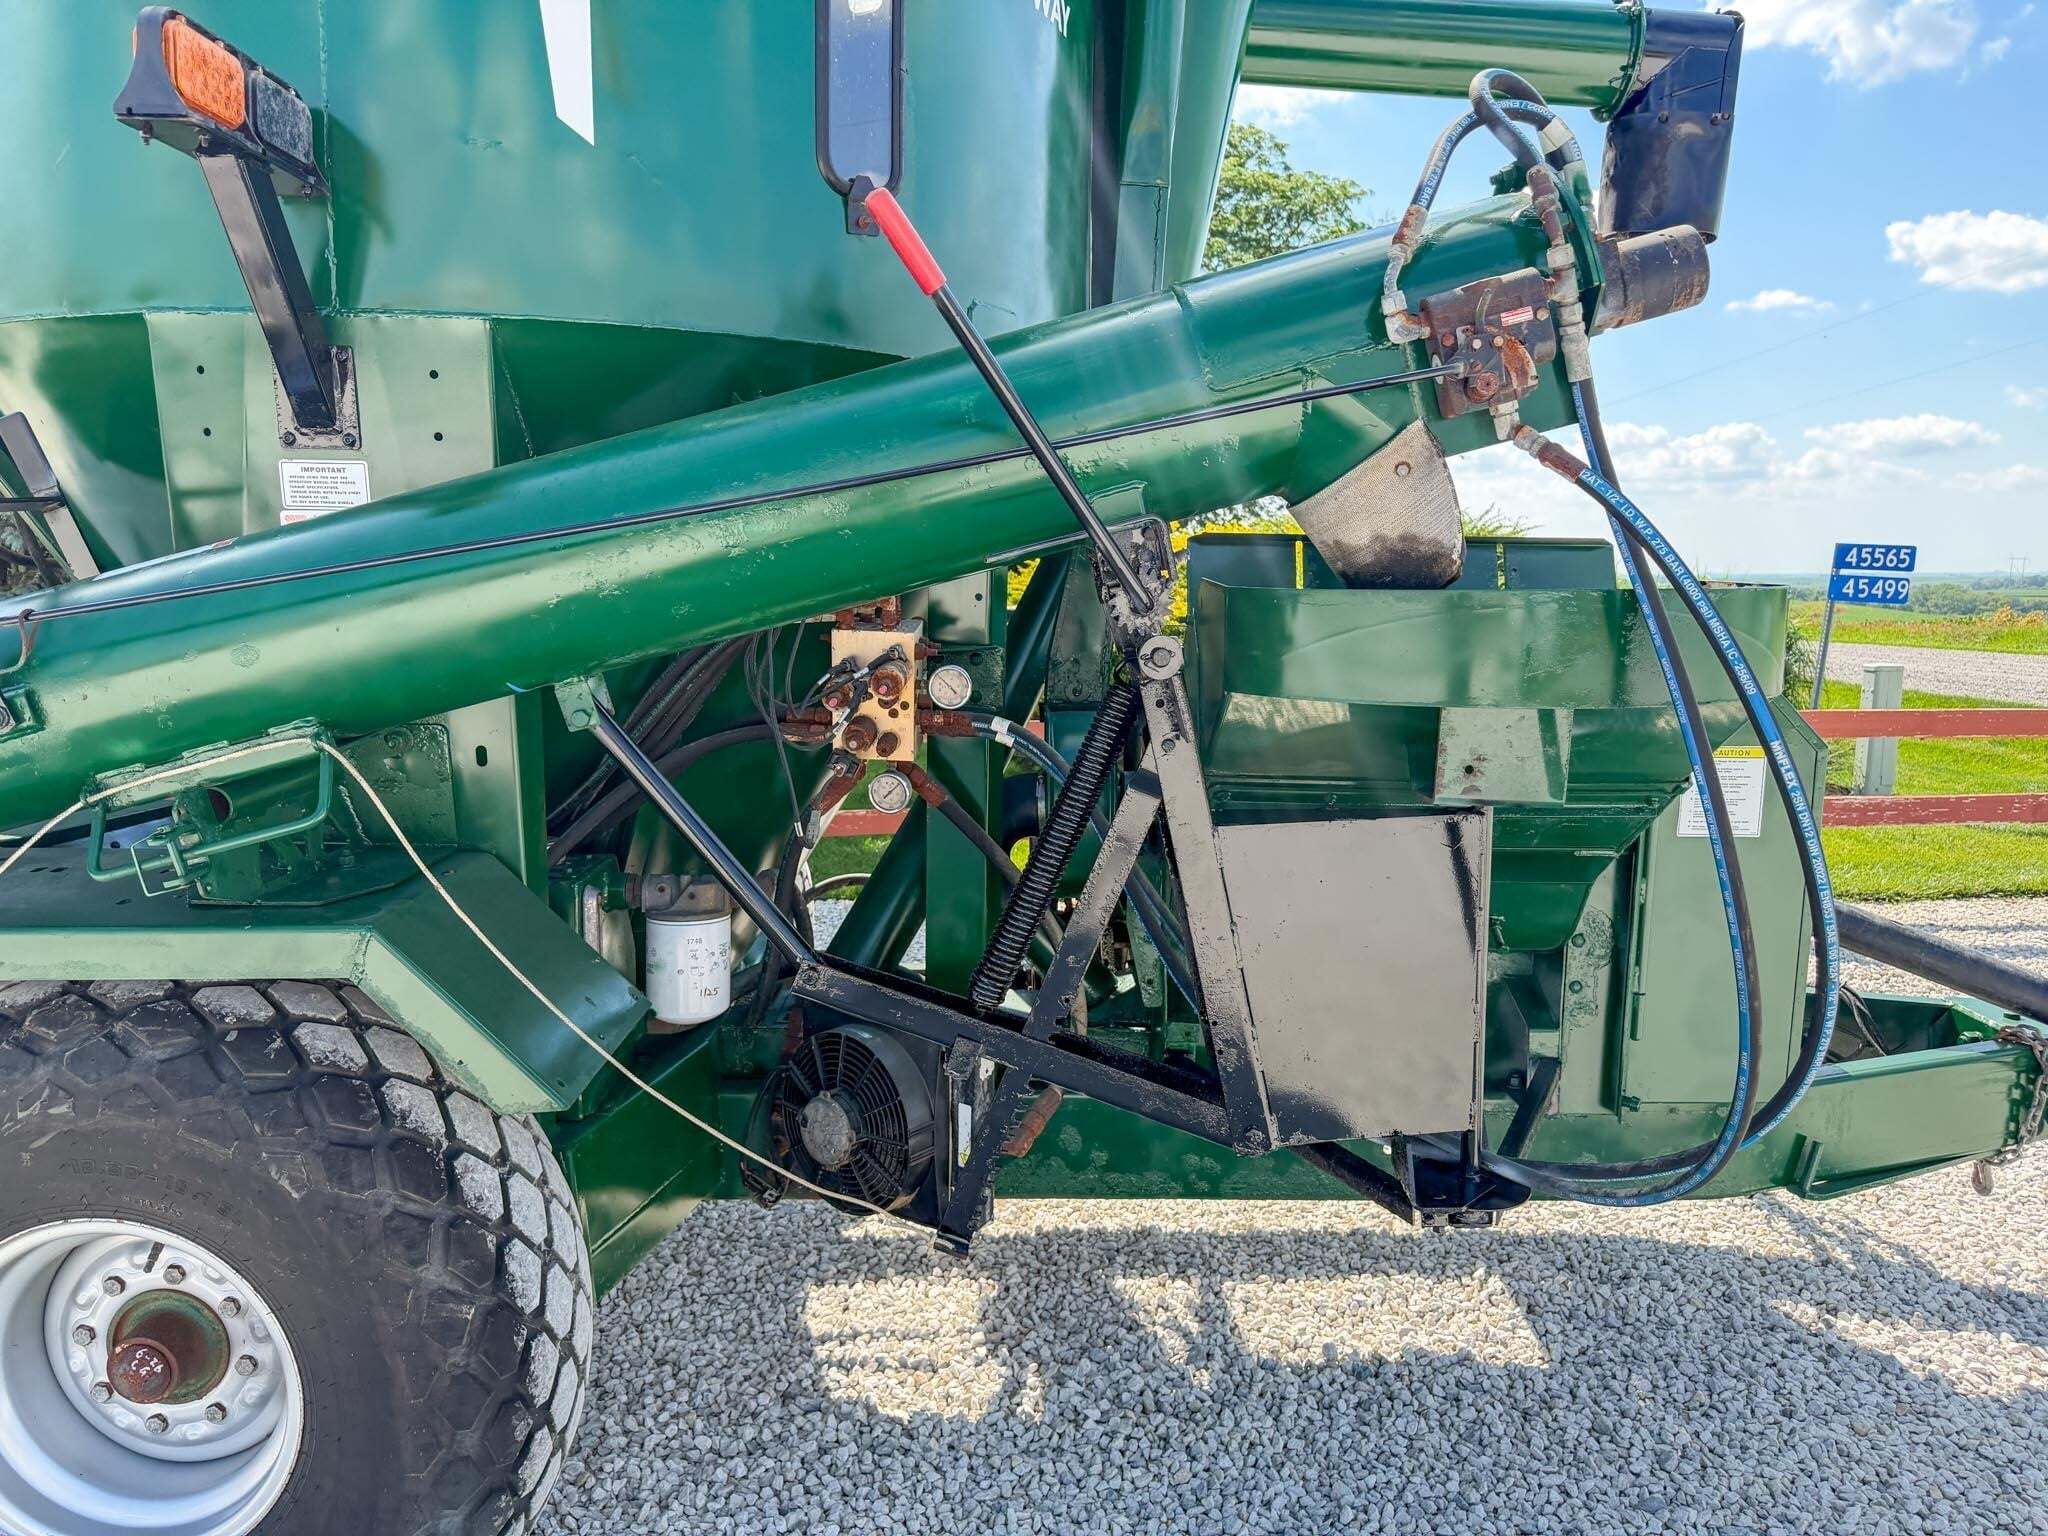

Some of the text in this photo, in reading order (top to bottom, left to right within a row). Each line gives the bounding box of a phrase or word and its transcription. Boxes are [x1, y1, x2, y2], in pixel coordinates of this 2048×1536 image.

[1418, 186, 1433, 207] BAR
[1845, 547, 1911, 568] 45565
[1620, 503, 1636, 520] I.D.
[1635, 518, 1653, 541] W.P.
[1651, 537, 1669, 556] 275
[1664, 554, 1685, 577] BAR
[1708, 617, 1732, 648] MSHA
[1842, 578, 1909, 599] 45499
[1692, 764, 1704, 786] KURT
[1790, 789, 1806, 811] 2SN
[1797, 811, 1814, 839] DN12
[1806, 838, 1820, 856] DIN
[1812, 858, 1826, 884] 20022
[1820, 890, 1833, 919] EN853
[1825, 923, 1837, 943] SAE
